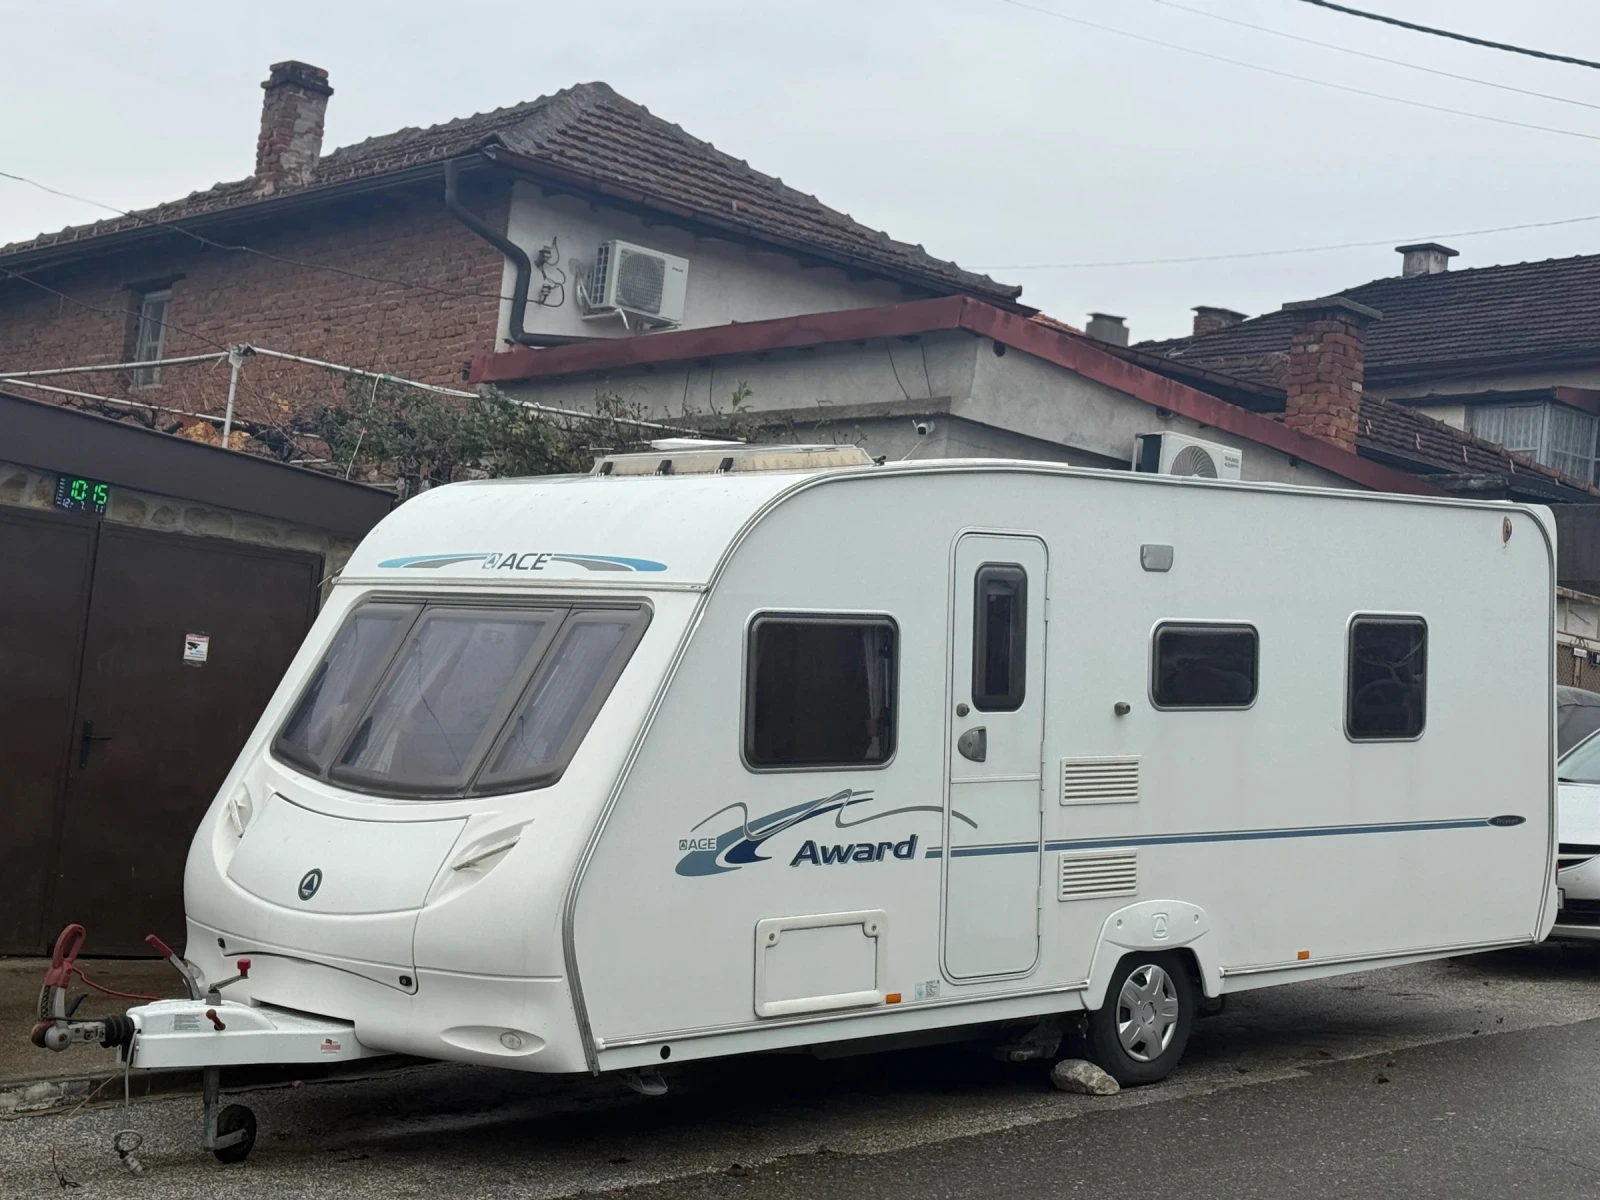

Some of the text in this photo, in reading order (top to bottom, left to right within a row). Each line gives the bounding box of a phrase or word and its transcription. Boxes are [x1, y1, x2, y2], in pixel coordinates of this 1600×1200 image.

[496, 553, 553, 570] ACE
[688, 838, 716, 851] ACE
[789, 834, 919, 867] Award
